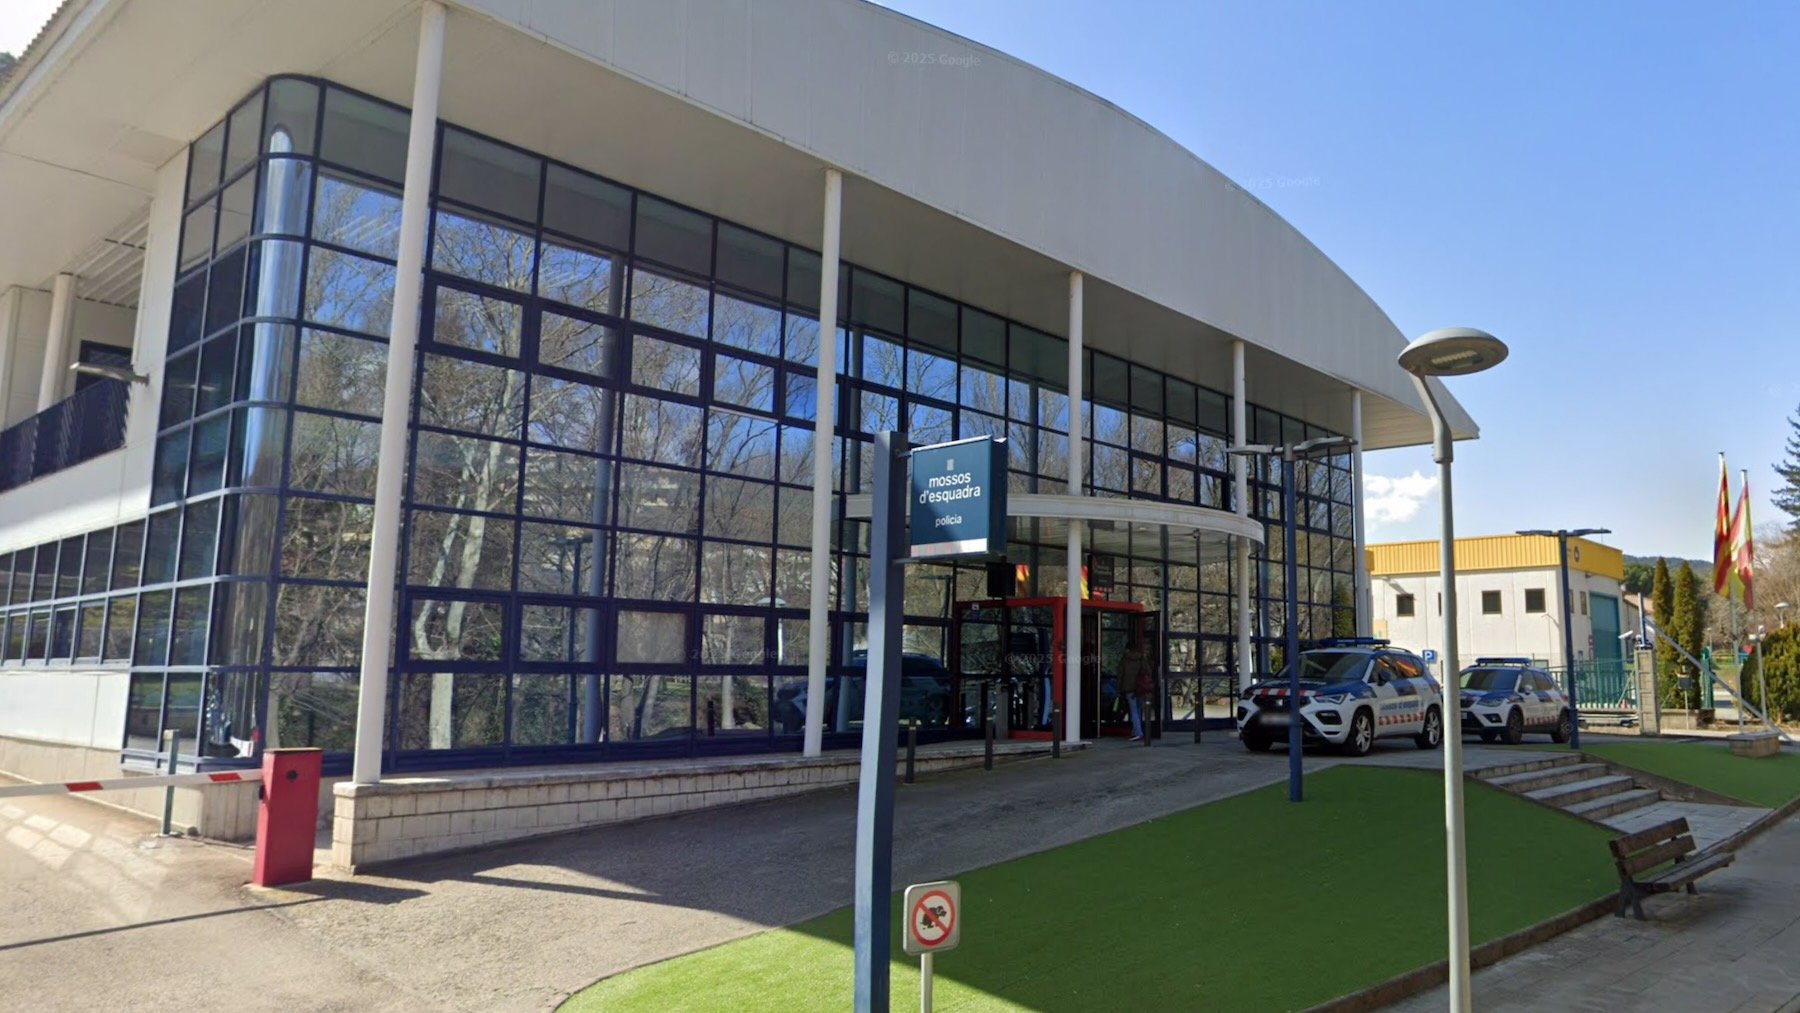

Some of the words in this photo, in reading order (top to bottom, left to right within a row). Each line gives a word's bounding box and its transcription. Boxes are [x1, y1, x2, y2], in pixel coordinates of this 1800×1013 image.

[929, 473, 971, 488] mossos
[919, 485, 981, 503] d'esquadra
[935, 514, 962, 527] policia
[1424, 651, 1433, 662] P
